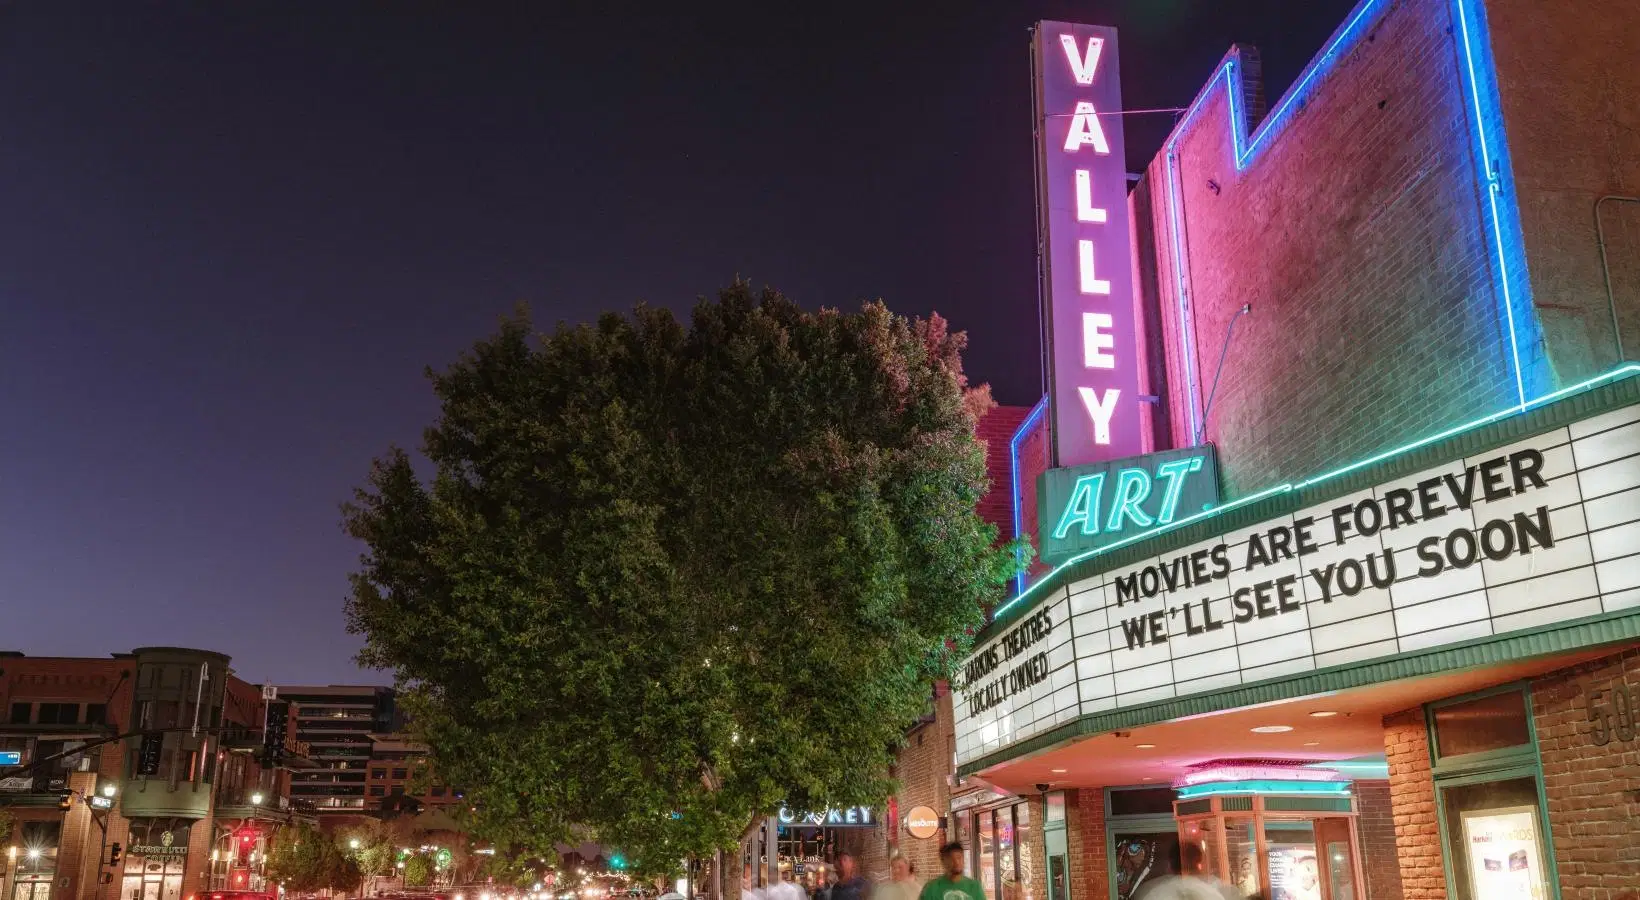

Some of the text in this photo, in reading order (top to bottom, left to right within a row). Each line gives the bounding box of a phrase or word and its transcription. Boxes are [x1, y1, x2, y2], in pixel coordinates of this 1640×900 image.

[1058, 33, 1121, 445] VALLEY
[1115, 448, 1549, 607] MOVIES ARE FOREVER
[1121, 505, 1555, 651] WE'LL SEE YOU SOON
[968, 650, 1048, 718] LOCALLY OWNED
[1001, 605, 1053, 662] THEATRES
[828, 806, 871, 824] KEY
